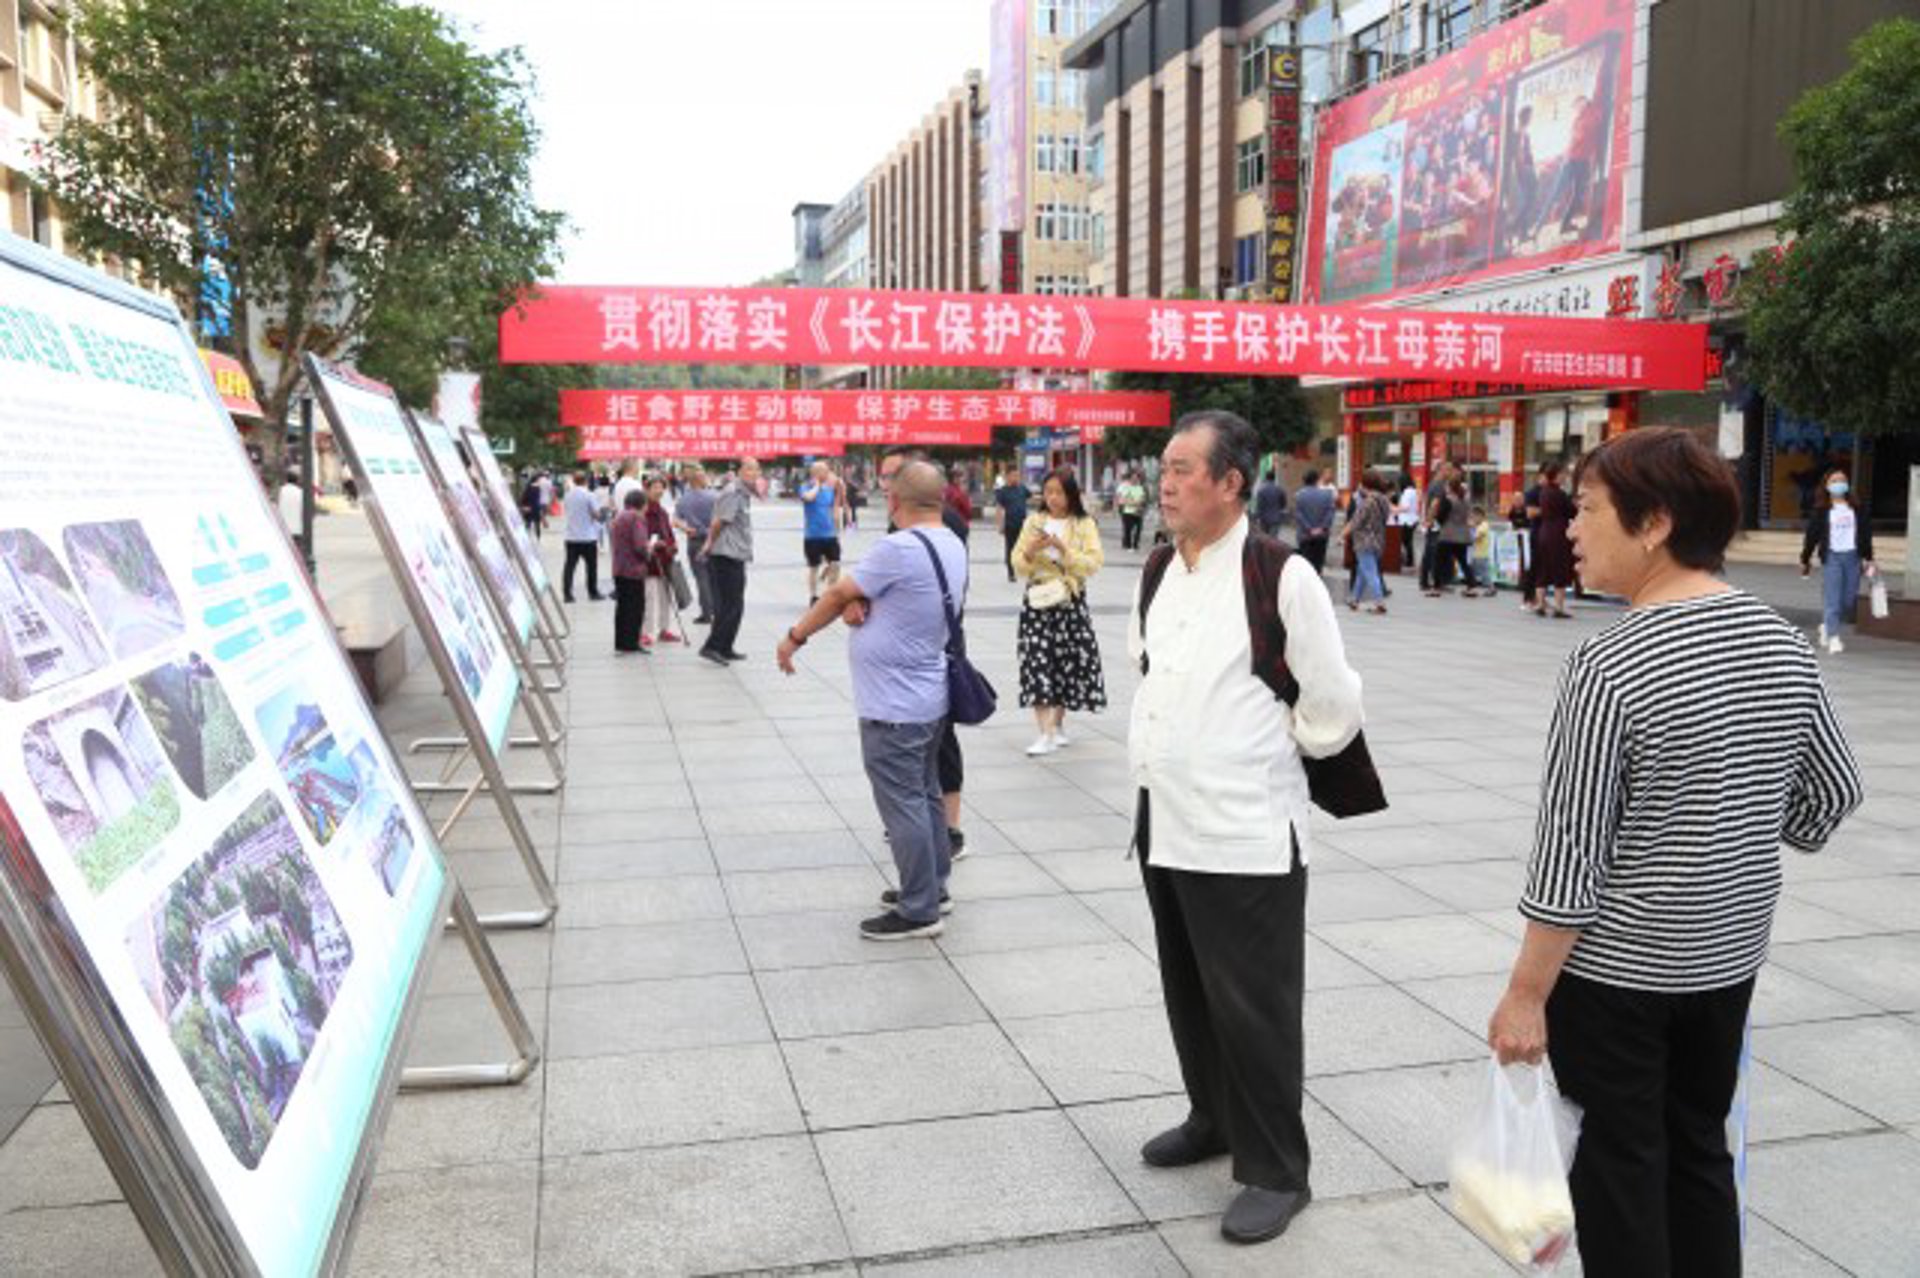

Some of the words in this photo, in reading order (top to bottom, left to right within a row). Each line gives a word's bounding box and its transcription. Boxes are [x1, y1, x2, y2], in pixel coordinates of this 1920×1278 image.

[600, 295, 1097, 358] 贯彻落实《长江保护法》
[1148, 309, 1505, 372] 携手保护长江母亲河
[607, 394, 822, 422] 拒食野生动物
[857, 394, 1057, 422] 保护生态平衡
